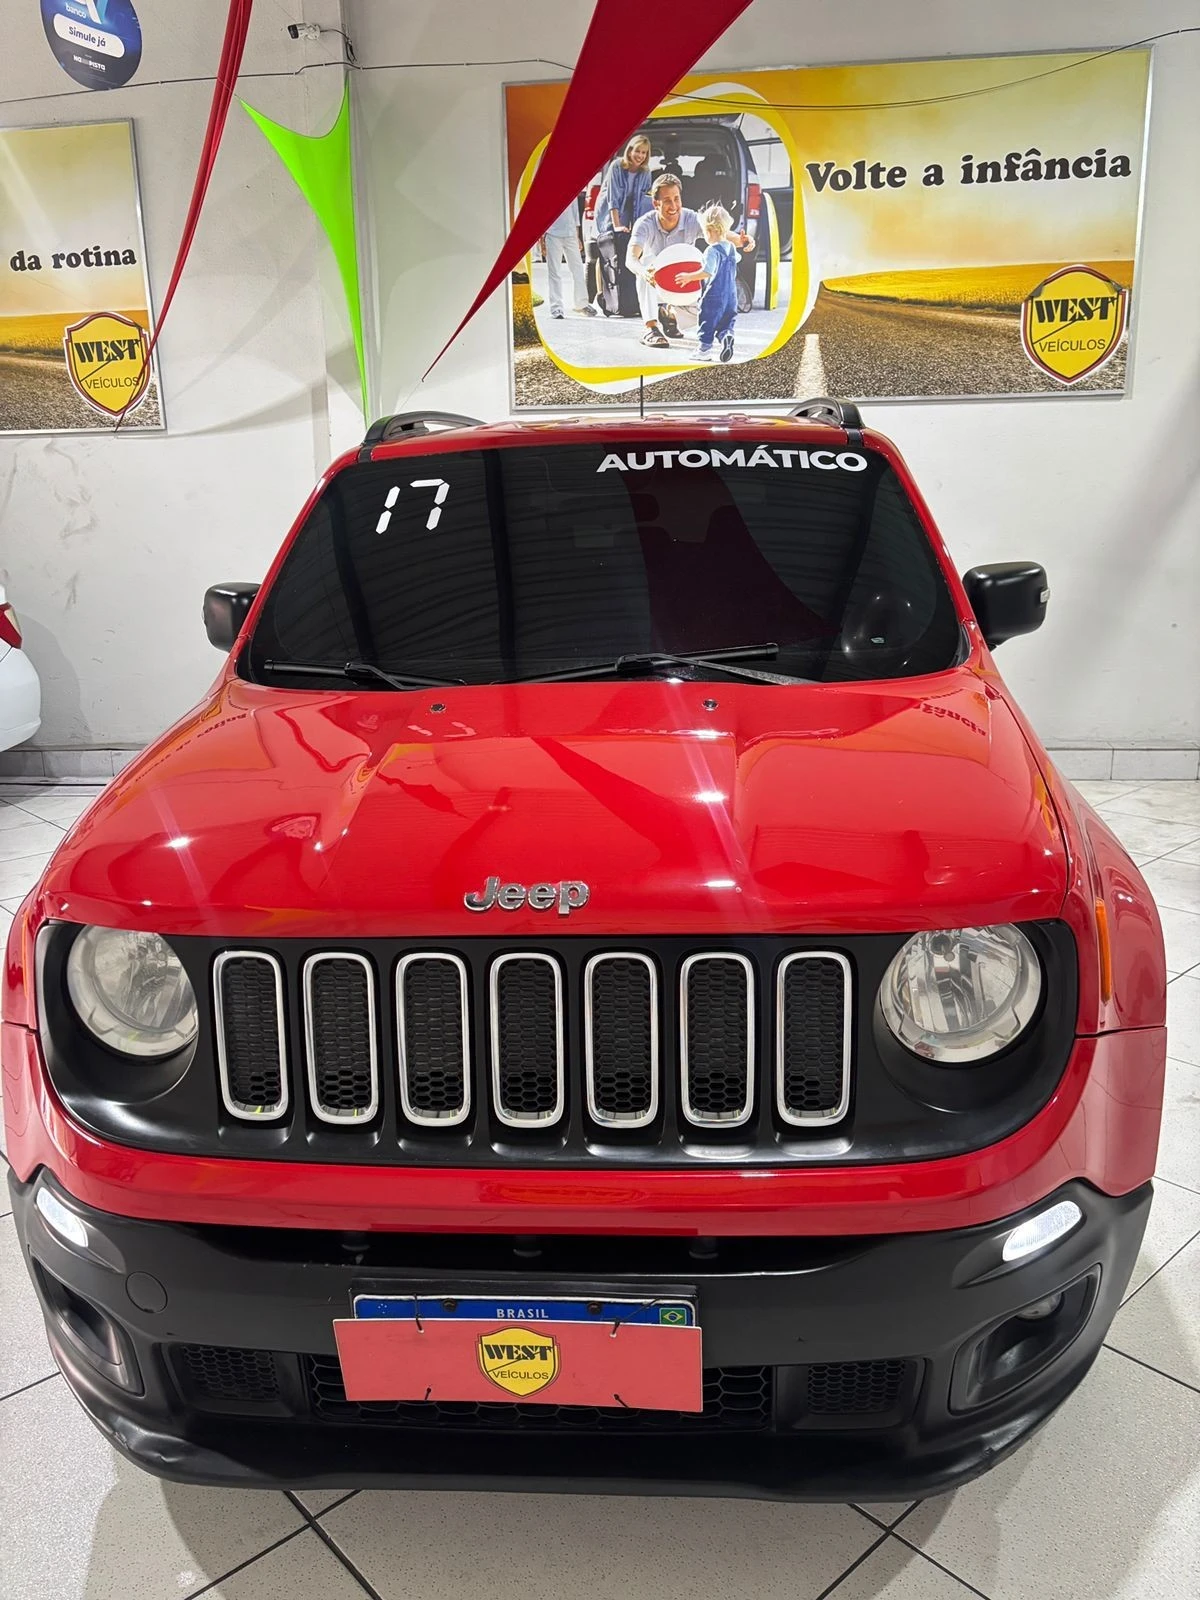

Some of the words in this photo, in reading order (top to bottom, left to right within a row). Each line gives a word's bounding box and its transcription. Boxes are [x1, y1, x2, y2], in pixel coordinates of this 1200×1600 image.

[65, 3, 87, 19] banco
[68, 26, 96, 44] Simule
[97, 36, 106, 47] já
[806, 160, 908, 193] Volte
[922, 163, 945, 187] a
[960, 148, 1132, 185] infância
[10, 250, 42, 272] da
[51, 245, 137, 270] rotina
[1035, 296, 1115, 323] WEST
[74, 338, 140, 363] WEST
[1039, 338, 1106, 353] VEÍCULOS
[85, 376, 139, 390] VEÍCULOS
[596, 444, 868, 473] AUTOMÁTICO
[375, 478, 450, 535] 17
[464, 876, 590, 915] Jeep
[496, 1307, 549, 1319] BRASIL
[484, 1344, 553, 1361] WEST
[492, 1369, 550, 1380] VEÍCULOS
